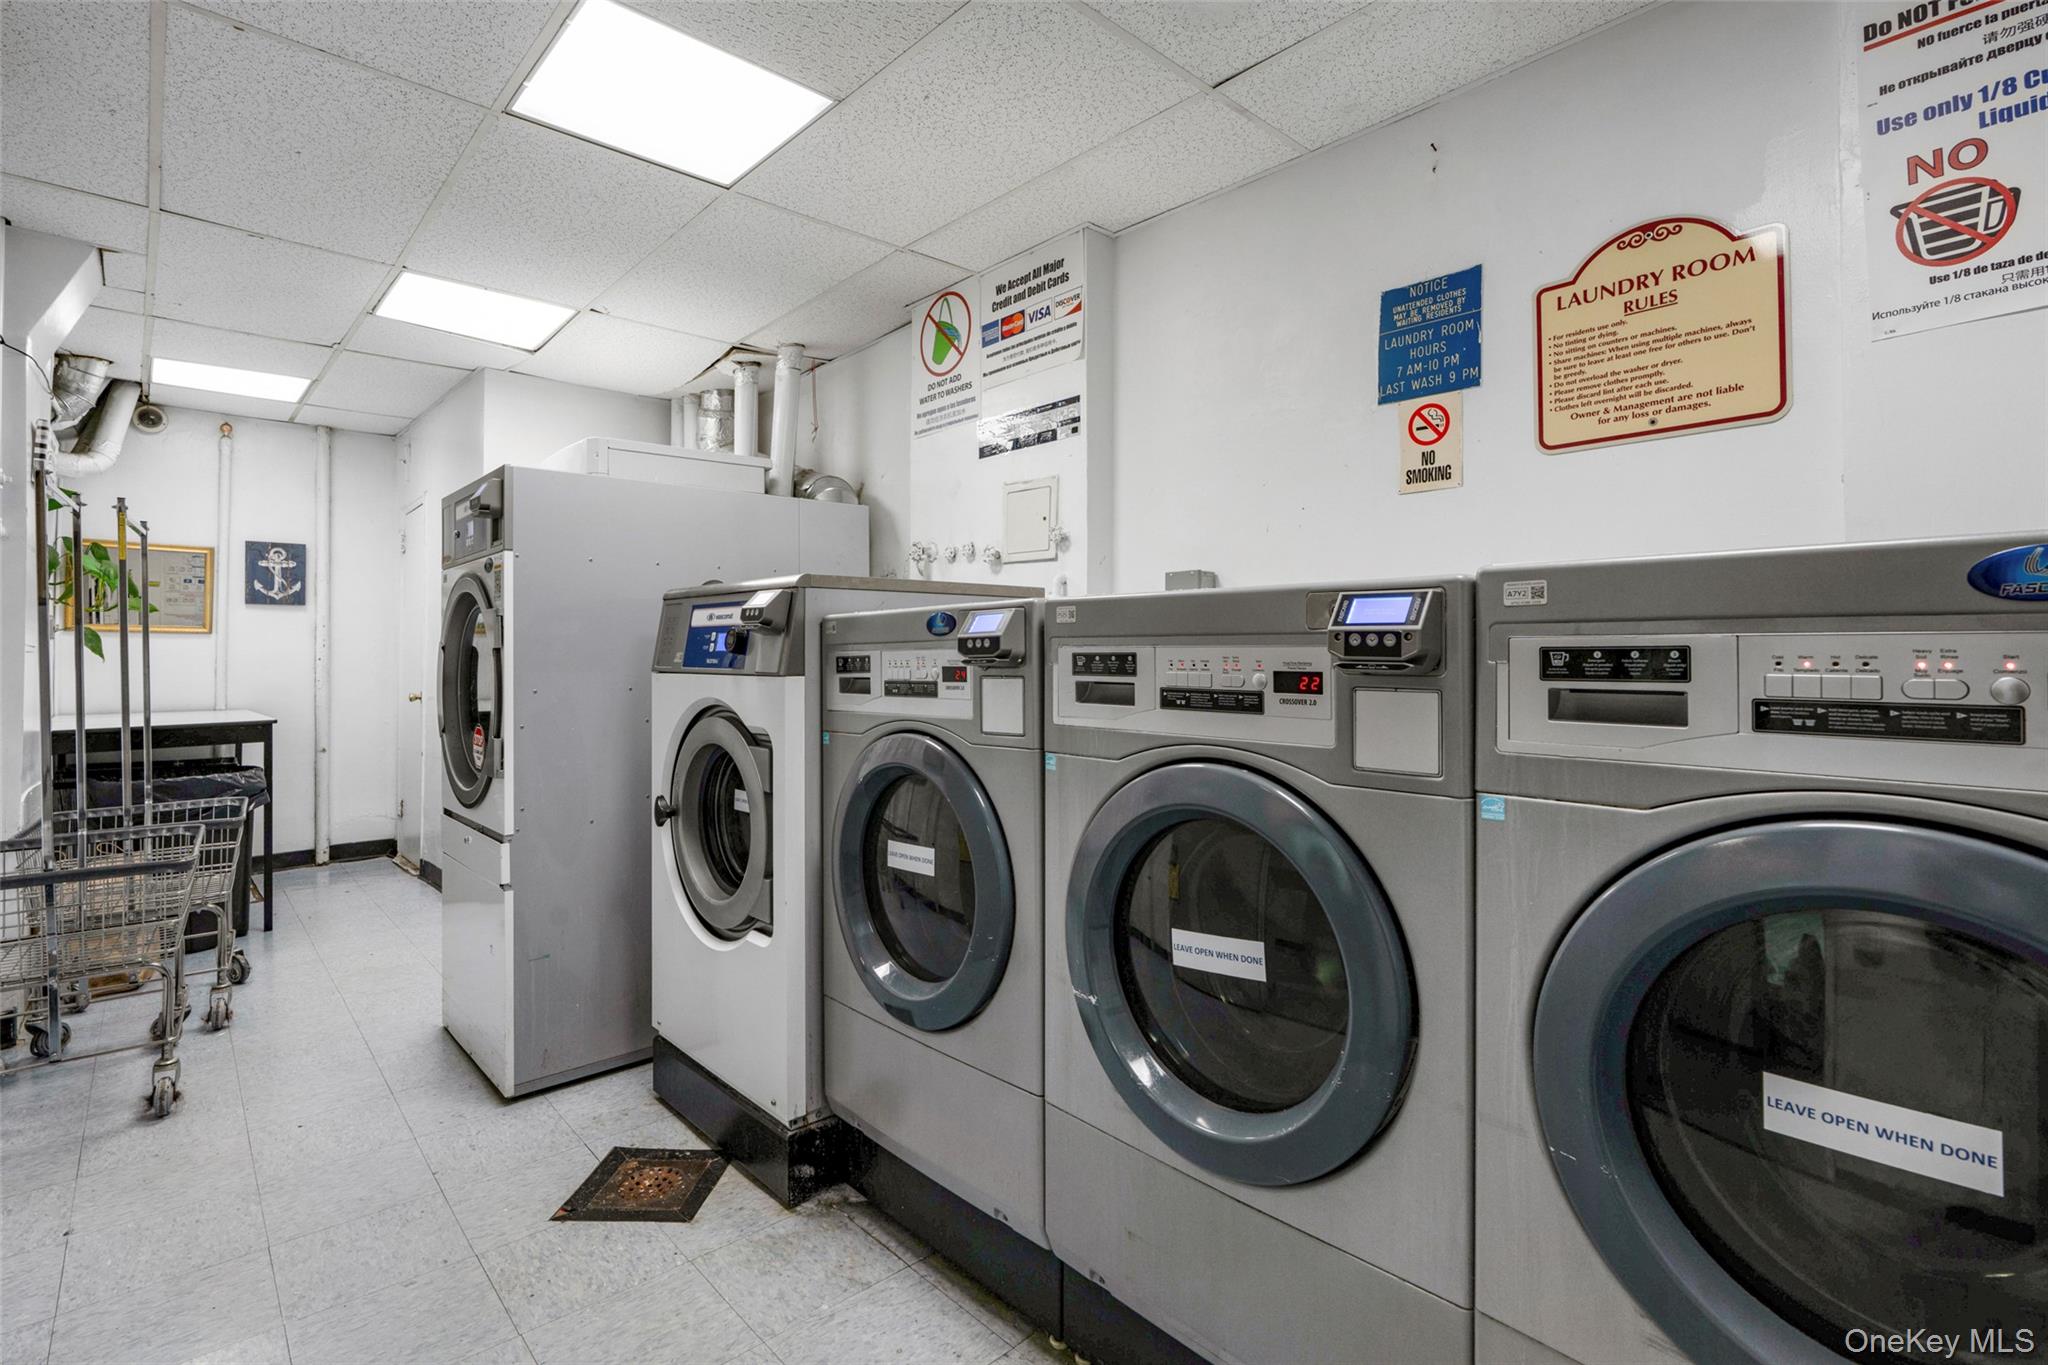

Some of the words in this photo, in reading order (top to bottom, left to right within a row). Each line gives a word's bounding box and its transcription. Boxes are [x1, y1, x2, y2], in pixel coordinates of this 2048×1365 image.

[1864, 20, 1892, 43] Do
[1898, 1, 1940, 30] NOT
[1917, 37, 1935, 49] NO
[1937, 20, 1982, 43] fuerce
[1985, 14, 1999, 25] la
[1879, 85, 1895, 96] Не
[1898, 53, 1983, 90] открывайте
[1986, 33, 2043, 61] дверцу
[1877, 111, 1918, 136] Use
[1923, 93, 1973, 121] only
[1978, 76, 2018, 103] 1/8
[1907, 137, 1988, 185] NO
[996, 284, 1006, 296] We
[1008, 272, 1031, 292] Accept
[1032, 266, 1041, 280] All
[1043, 258, 1065, 275] Major
[1556, 269, 1664, 311] LAUNDRY
[1672, 246, 1757, 282] ROOM
[1929, 274, 1951, 285] Use
[1953, 268, 1971, 279] 1/8
[1974, 263, 1988, 275] de
[1991, 259, 2015, 270] taza
[2018, 255, 2033, 264] de
[992, 295, 1012, 313] Credit
[1013, 289, 1026, 303] and
[1027, 281, 1046, 298] Debit
[1048, 272, 1070, 289] Cards
[1409, 277, 1448, 298] NOTICE
[1055, 293, 1080, 308] DISCOVER
[1393, 296, 1433, 313] UNATTENDED
[1437, 288, 1467, 302] CLOTHES
[1394, 312, 1407, 320] MAY
[1422, 301, 1453, 314] REMOVED
[1457, 297, 1466, 305] BY
[1426, 306, 1461, 320] RESIDENTS
[1623, 289, 1678, 314] RULES
[1872, 300, 1941, 320] Используйте
[1944, 293, 1961, 305] 1/8
[1964, 284, 2009, 301] стакана
[1029, 305, 1051, 323] VISA
[1385, 329, 1434, 350] LAUNDRY
[1441, 319, 1474, 337] ROOM
[1410, 341, 1447, 359] HOURS
[1397, 366, 1403, 377] 7
[1444, 353, 1460, 368] PM
[928, 382, 936, 391] DO
[937, 378, 948, 388] NOT
[949, 374, 961, 384] ADD
[938, 391, 944, 399] TO
[946, 381, 972, 396] WASHERS
[1380, 382, 1405, 397] LAST
[1411, 374, 1442, 390] WASH
[1449, 372, 1455, 383] 9
[1463, 367, 1478, 380] PM
[1570, 410, 1600, 420] Owner
[1603, 407, 1610, 415] &
[1613, 396, 1675, 413] Management
[1677, 393, 1693, 402] are
[1696, 389, 1713, 399] not
[1716, 383, 1745, 395] liable
[1598, 417, 1611, 425] for
[1613, 414, 1629, 423] any
[1631, 409, 1649, 419] loss
[1652, 408, 1663, 416] or
[1665, 401, 1711, 414] damages.
[1422, 450, 1435, 466] NO
[1406, 465, 1451, 485] SMOKING
[1300, 676, 1320, 690] 22
[1174, 944, 1193, 953] LEAVE
[1194, 948, 1214, 957] OPEN
[1215, 951, 1239, 961] WHEN
[1241, 955, 1263, 966] DONE
[1766, 1095, 1817, 1120] LEAVE
[1821, 1112, 1870, 1135] OPEN
[1875, 1125, 1934, 1152] WHEN
[1940, 1143, 1998, 1169] DONE
